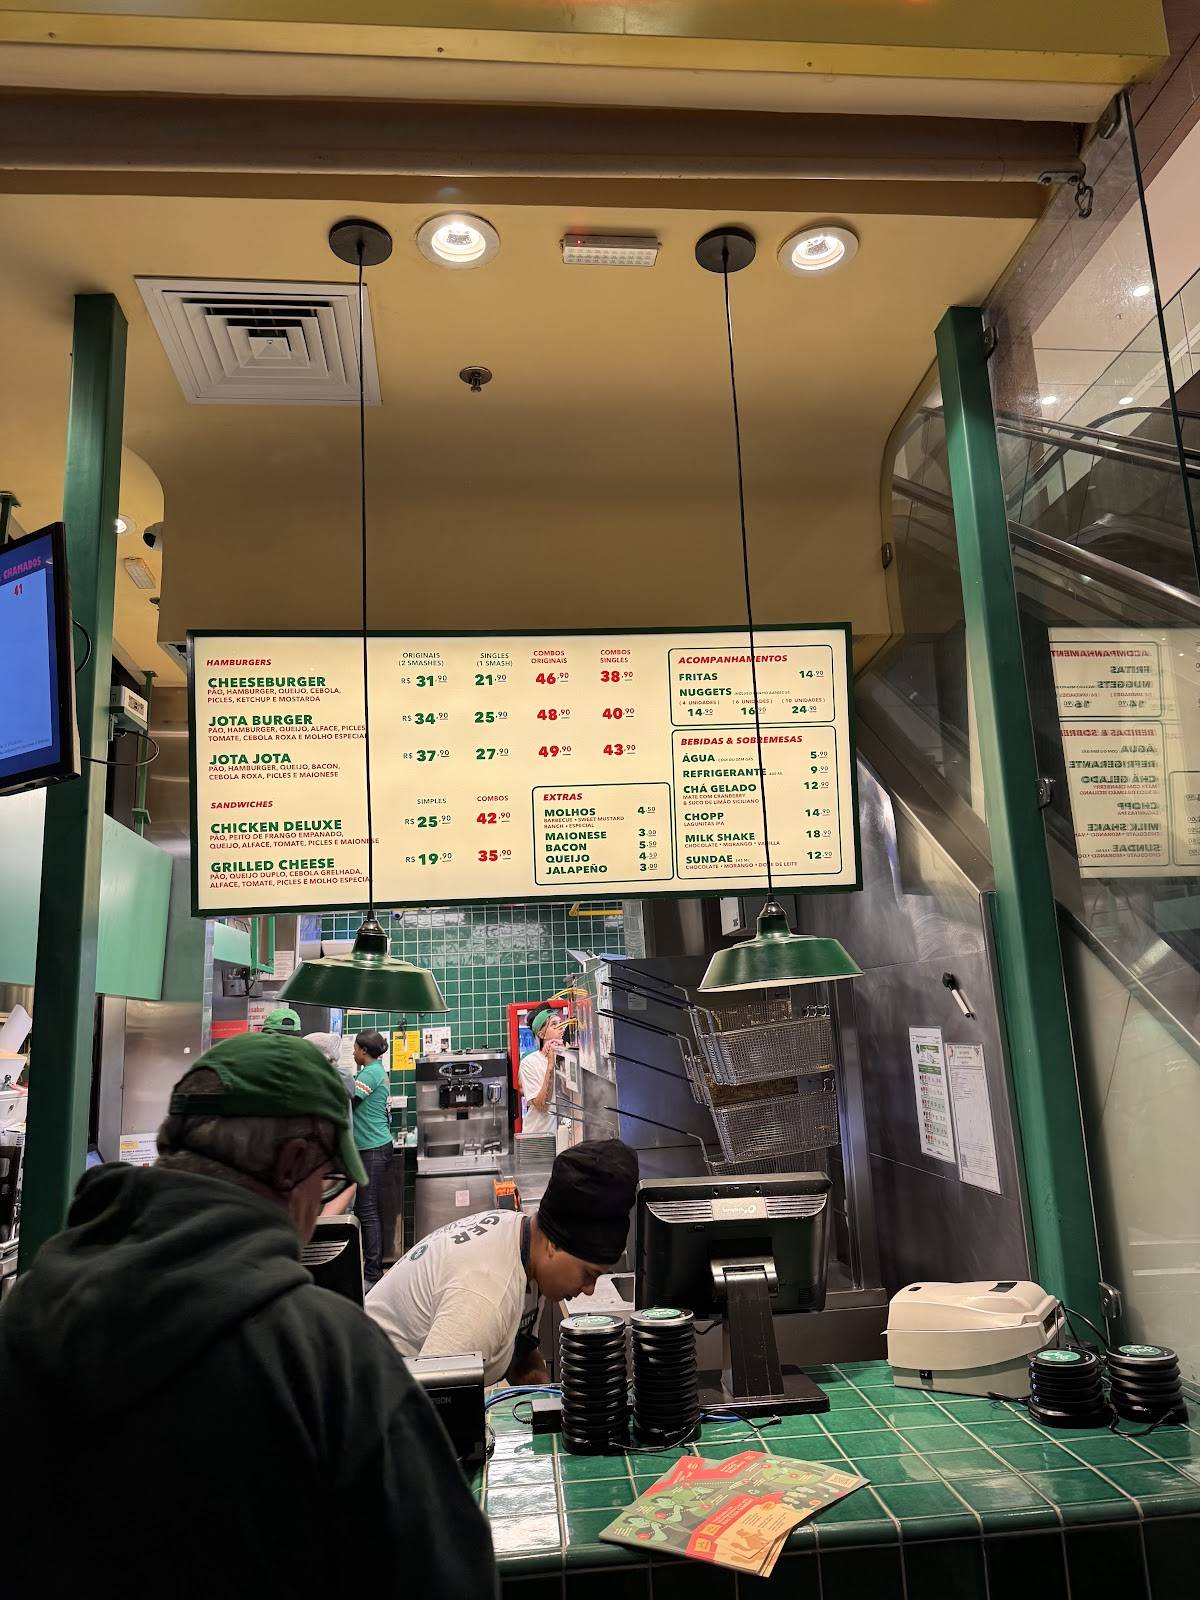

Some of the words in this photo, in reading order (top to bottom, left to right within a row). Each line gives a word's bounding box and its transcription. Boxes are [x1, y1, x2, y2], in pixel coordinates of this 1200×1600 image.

[208, 677, 325, 687] CHEESEBURGER
[679, 688, 731, 696] NUGGETS
[209, 716, 247, 726] JOTA
[253, 715, 312, 725] BURGER
[210, 755, 248, 765] JOTA
[253, 753, 291, 764] JOTA
[683, 753, 715, 762] ÁGUA
[683, 769, 766, 778] REFRIGERANTE
[684, 783, 707, 793] CHÁ
[711, 784, 756, 792] GELADO
[544, 793, 582, 801] EXTRAS
[545, 808, 595, 817] MOLHOS
[684, 812, 724, 821] CHOPP
[211, 822, 278, 833] CHICKEN
[284, 820, 342, 831] DELUXE
[546, 832, 606, 840] MAIONESE
[686, 834, 713, 842] MILK
[717, 833, 755, 841] SHAKE
[546, 843, 586, 851] BACON
[686, 855, 732, 864] SUNDAE
[211, 861, 273, 872] GRILLED
[279, 858, 334, 870] CHEESE
[546, 864, 607, 874] JALAPEÑO
